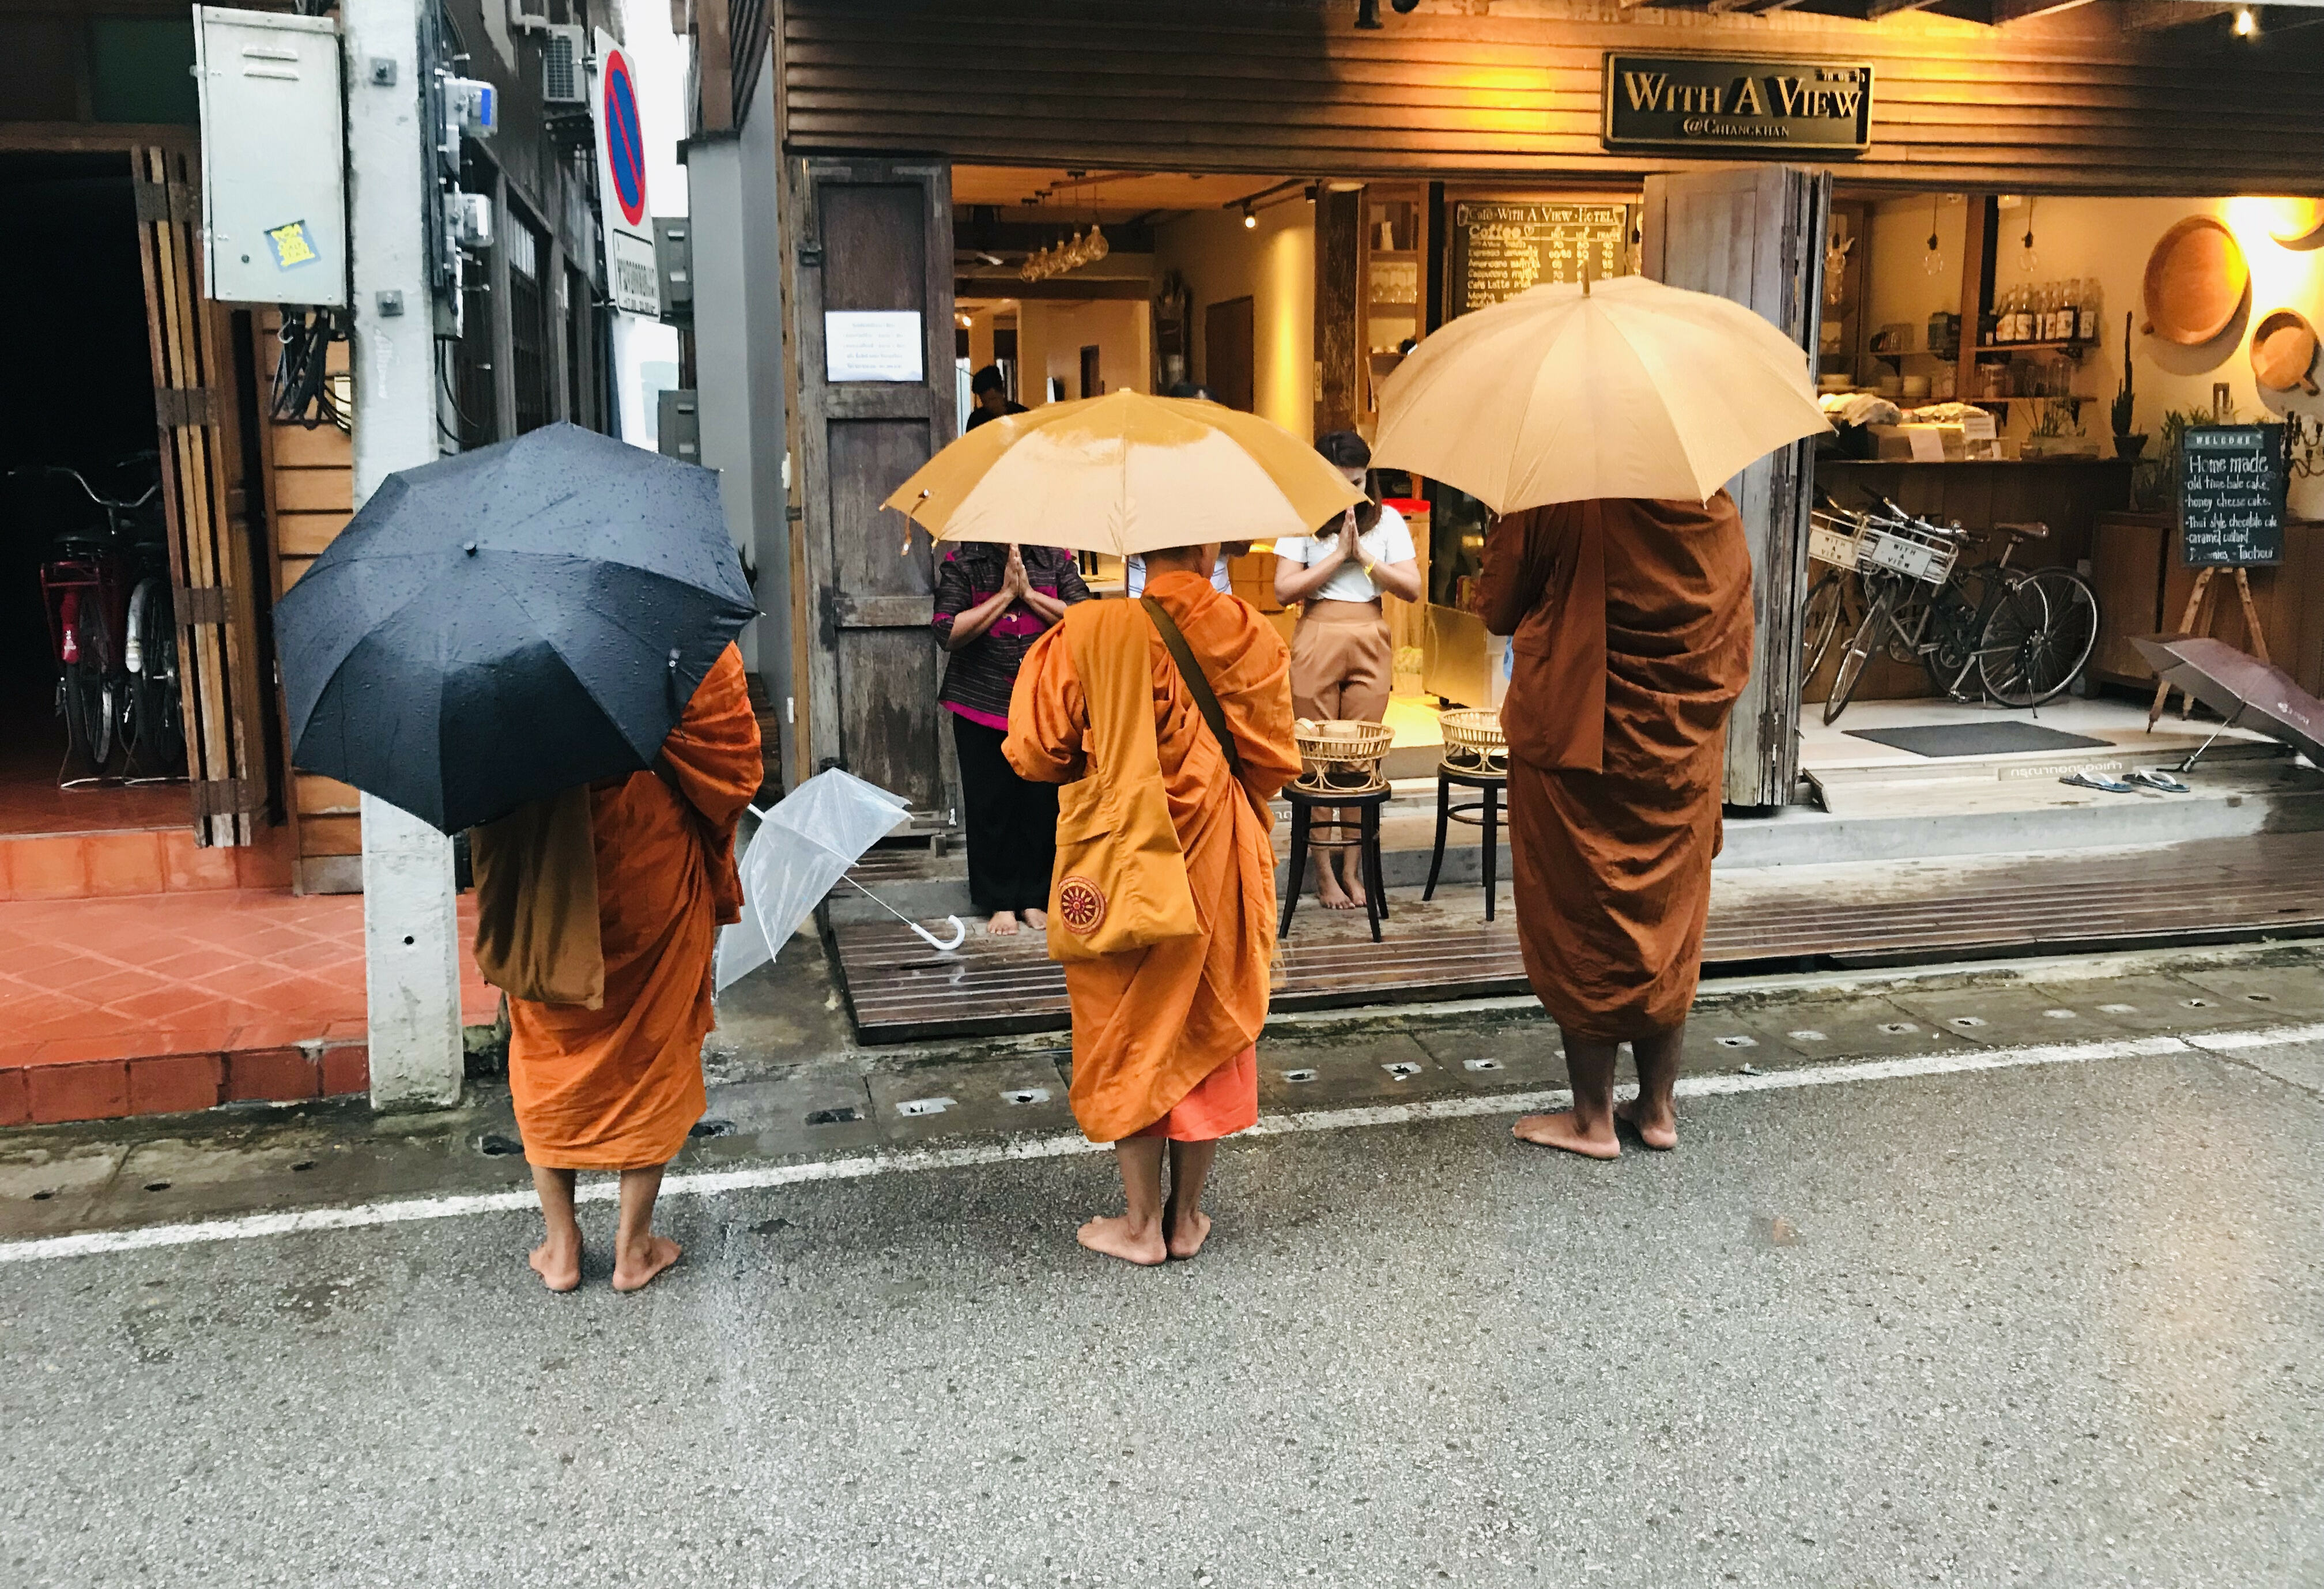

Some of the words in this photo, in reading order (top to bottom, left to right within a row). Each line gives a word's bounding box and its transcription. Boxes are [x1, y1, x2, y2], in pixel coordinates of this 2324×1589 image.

[1621, 71, 1721, 114] WITH
[1734, 77, 1763, 115] A
[1775, 77, 1863, 118] VIEW
[1526, 207, 1537, 221] A
[1469, 225, 1522, 240] Coffee
[2196, 435, 2250, 445] WELCOME
[2190, 455, 2227, 474] Home
[2230, 449, 2269, 473] made
